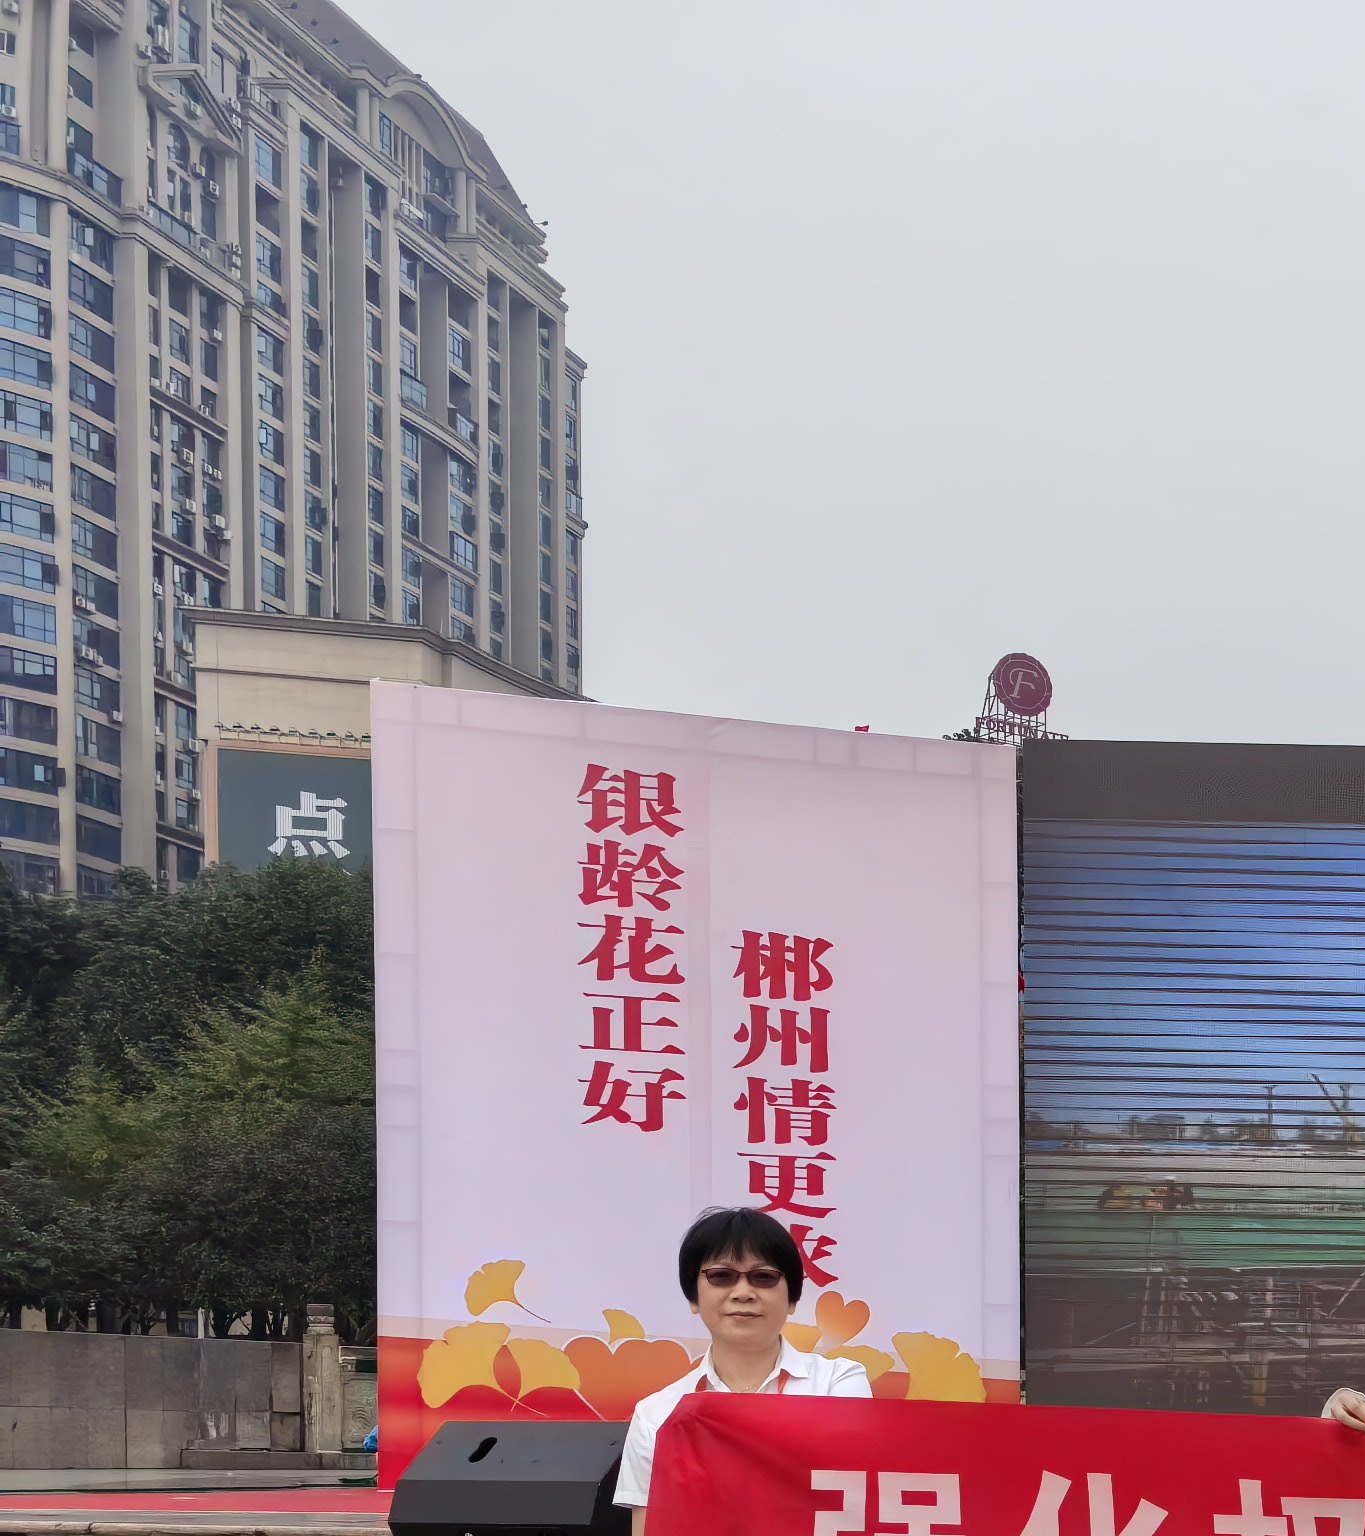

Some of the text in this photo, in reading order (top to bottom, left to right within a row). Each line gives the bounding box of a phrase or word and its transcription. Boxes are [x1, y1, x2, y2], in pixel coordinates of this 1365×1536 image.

[267, 790, 351, 859] 点
[577, 763, 687, 1133] 银龄花正好
